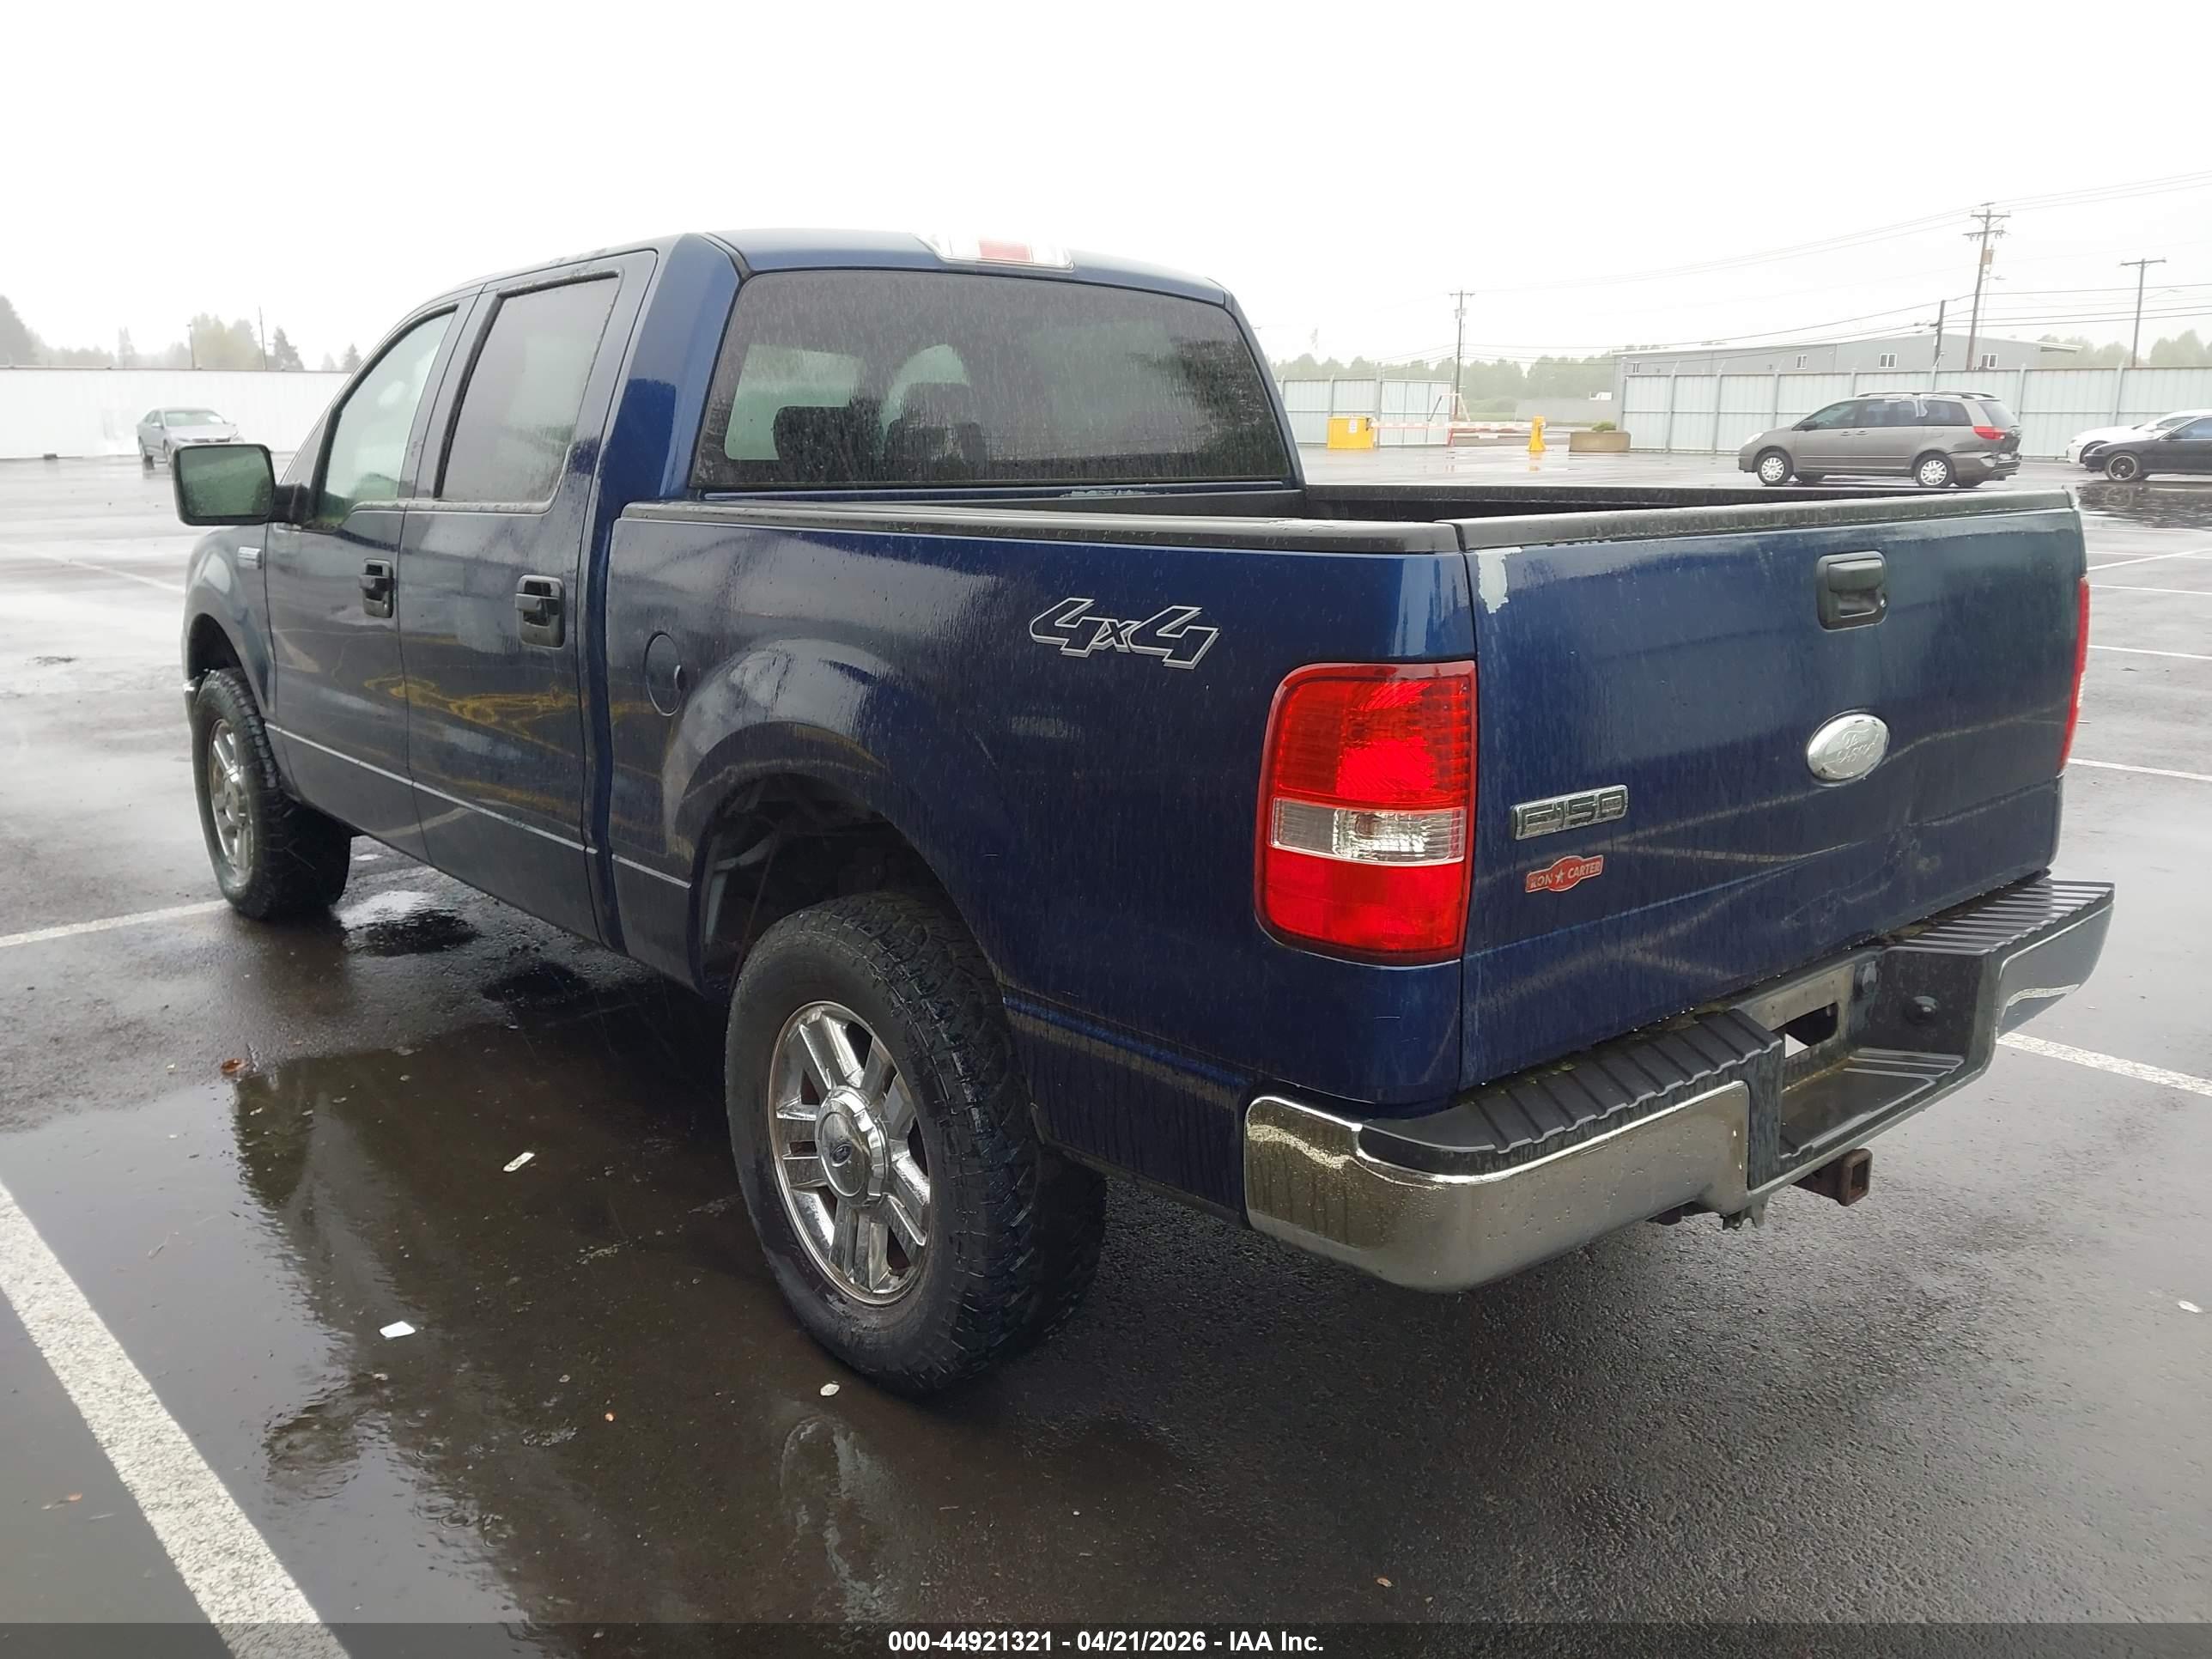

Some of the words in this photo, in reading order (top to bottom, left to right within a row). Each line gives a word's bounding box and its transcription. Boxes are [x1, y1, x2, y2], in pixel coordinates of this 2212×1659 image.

[1030, 598, 1220, 670] 4x4
[1530, 872, 1553, 889] RON
[1567, 860, 1601, 879] CARTER
